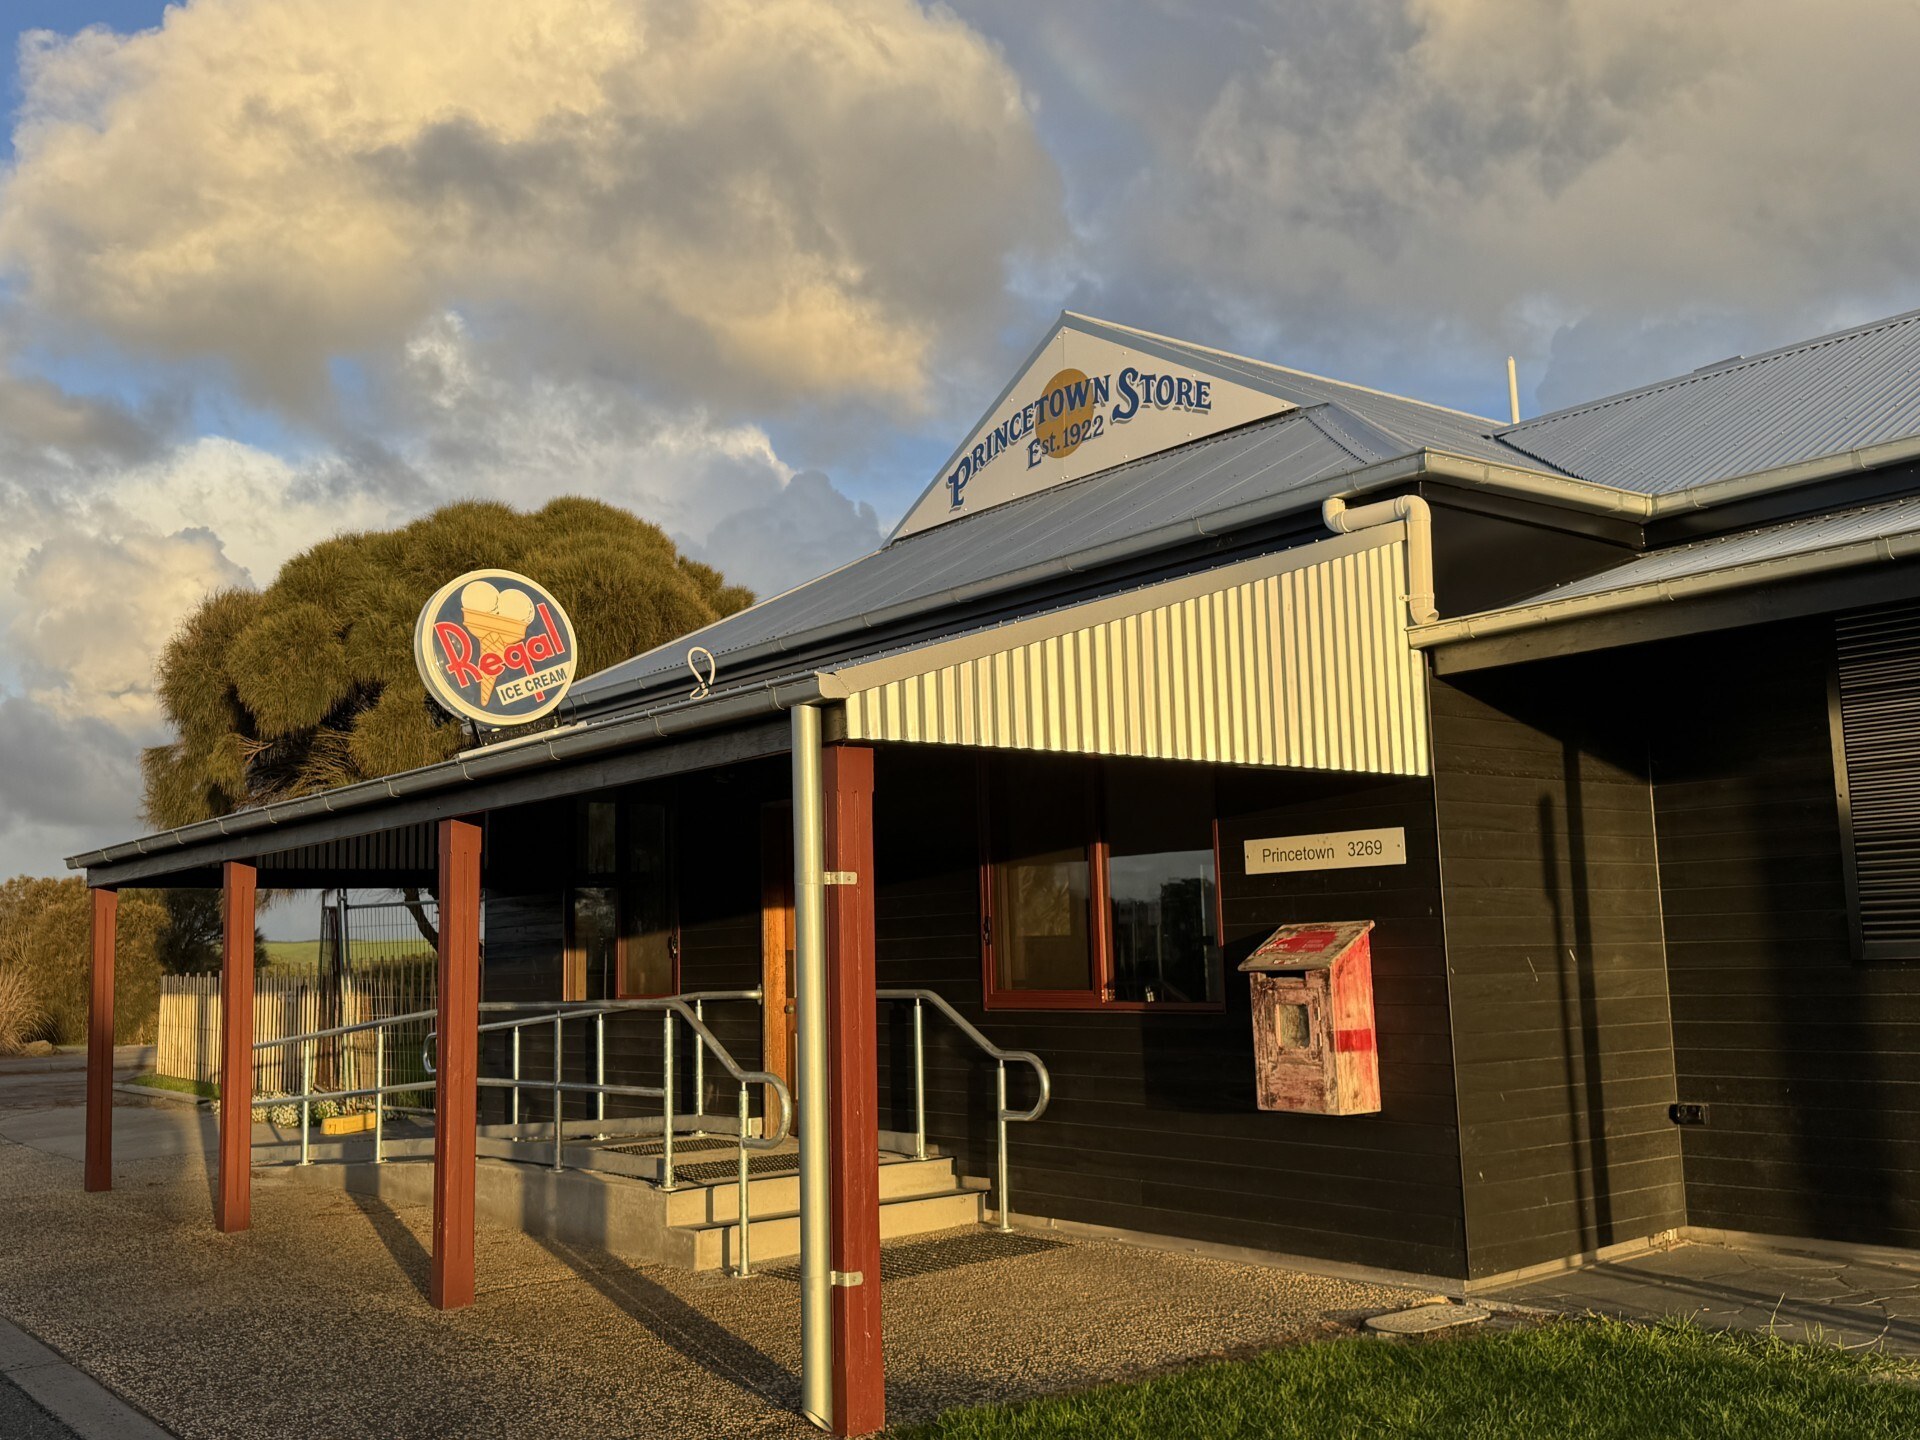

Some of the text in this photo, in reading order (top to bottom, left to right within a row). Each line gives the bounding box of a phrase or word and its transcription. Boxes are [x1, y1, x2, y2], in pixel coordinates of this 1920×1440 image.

[1063, 414, 1104, 449] 1922
[434, 602, 566, 703] Regal
[500, 668, 567, 701] ICE CREAM
[1262, 840, 1383, 863] Princetown 3269
